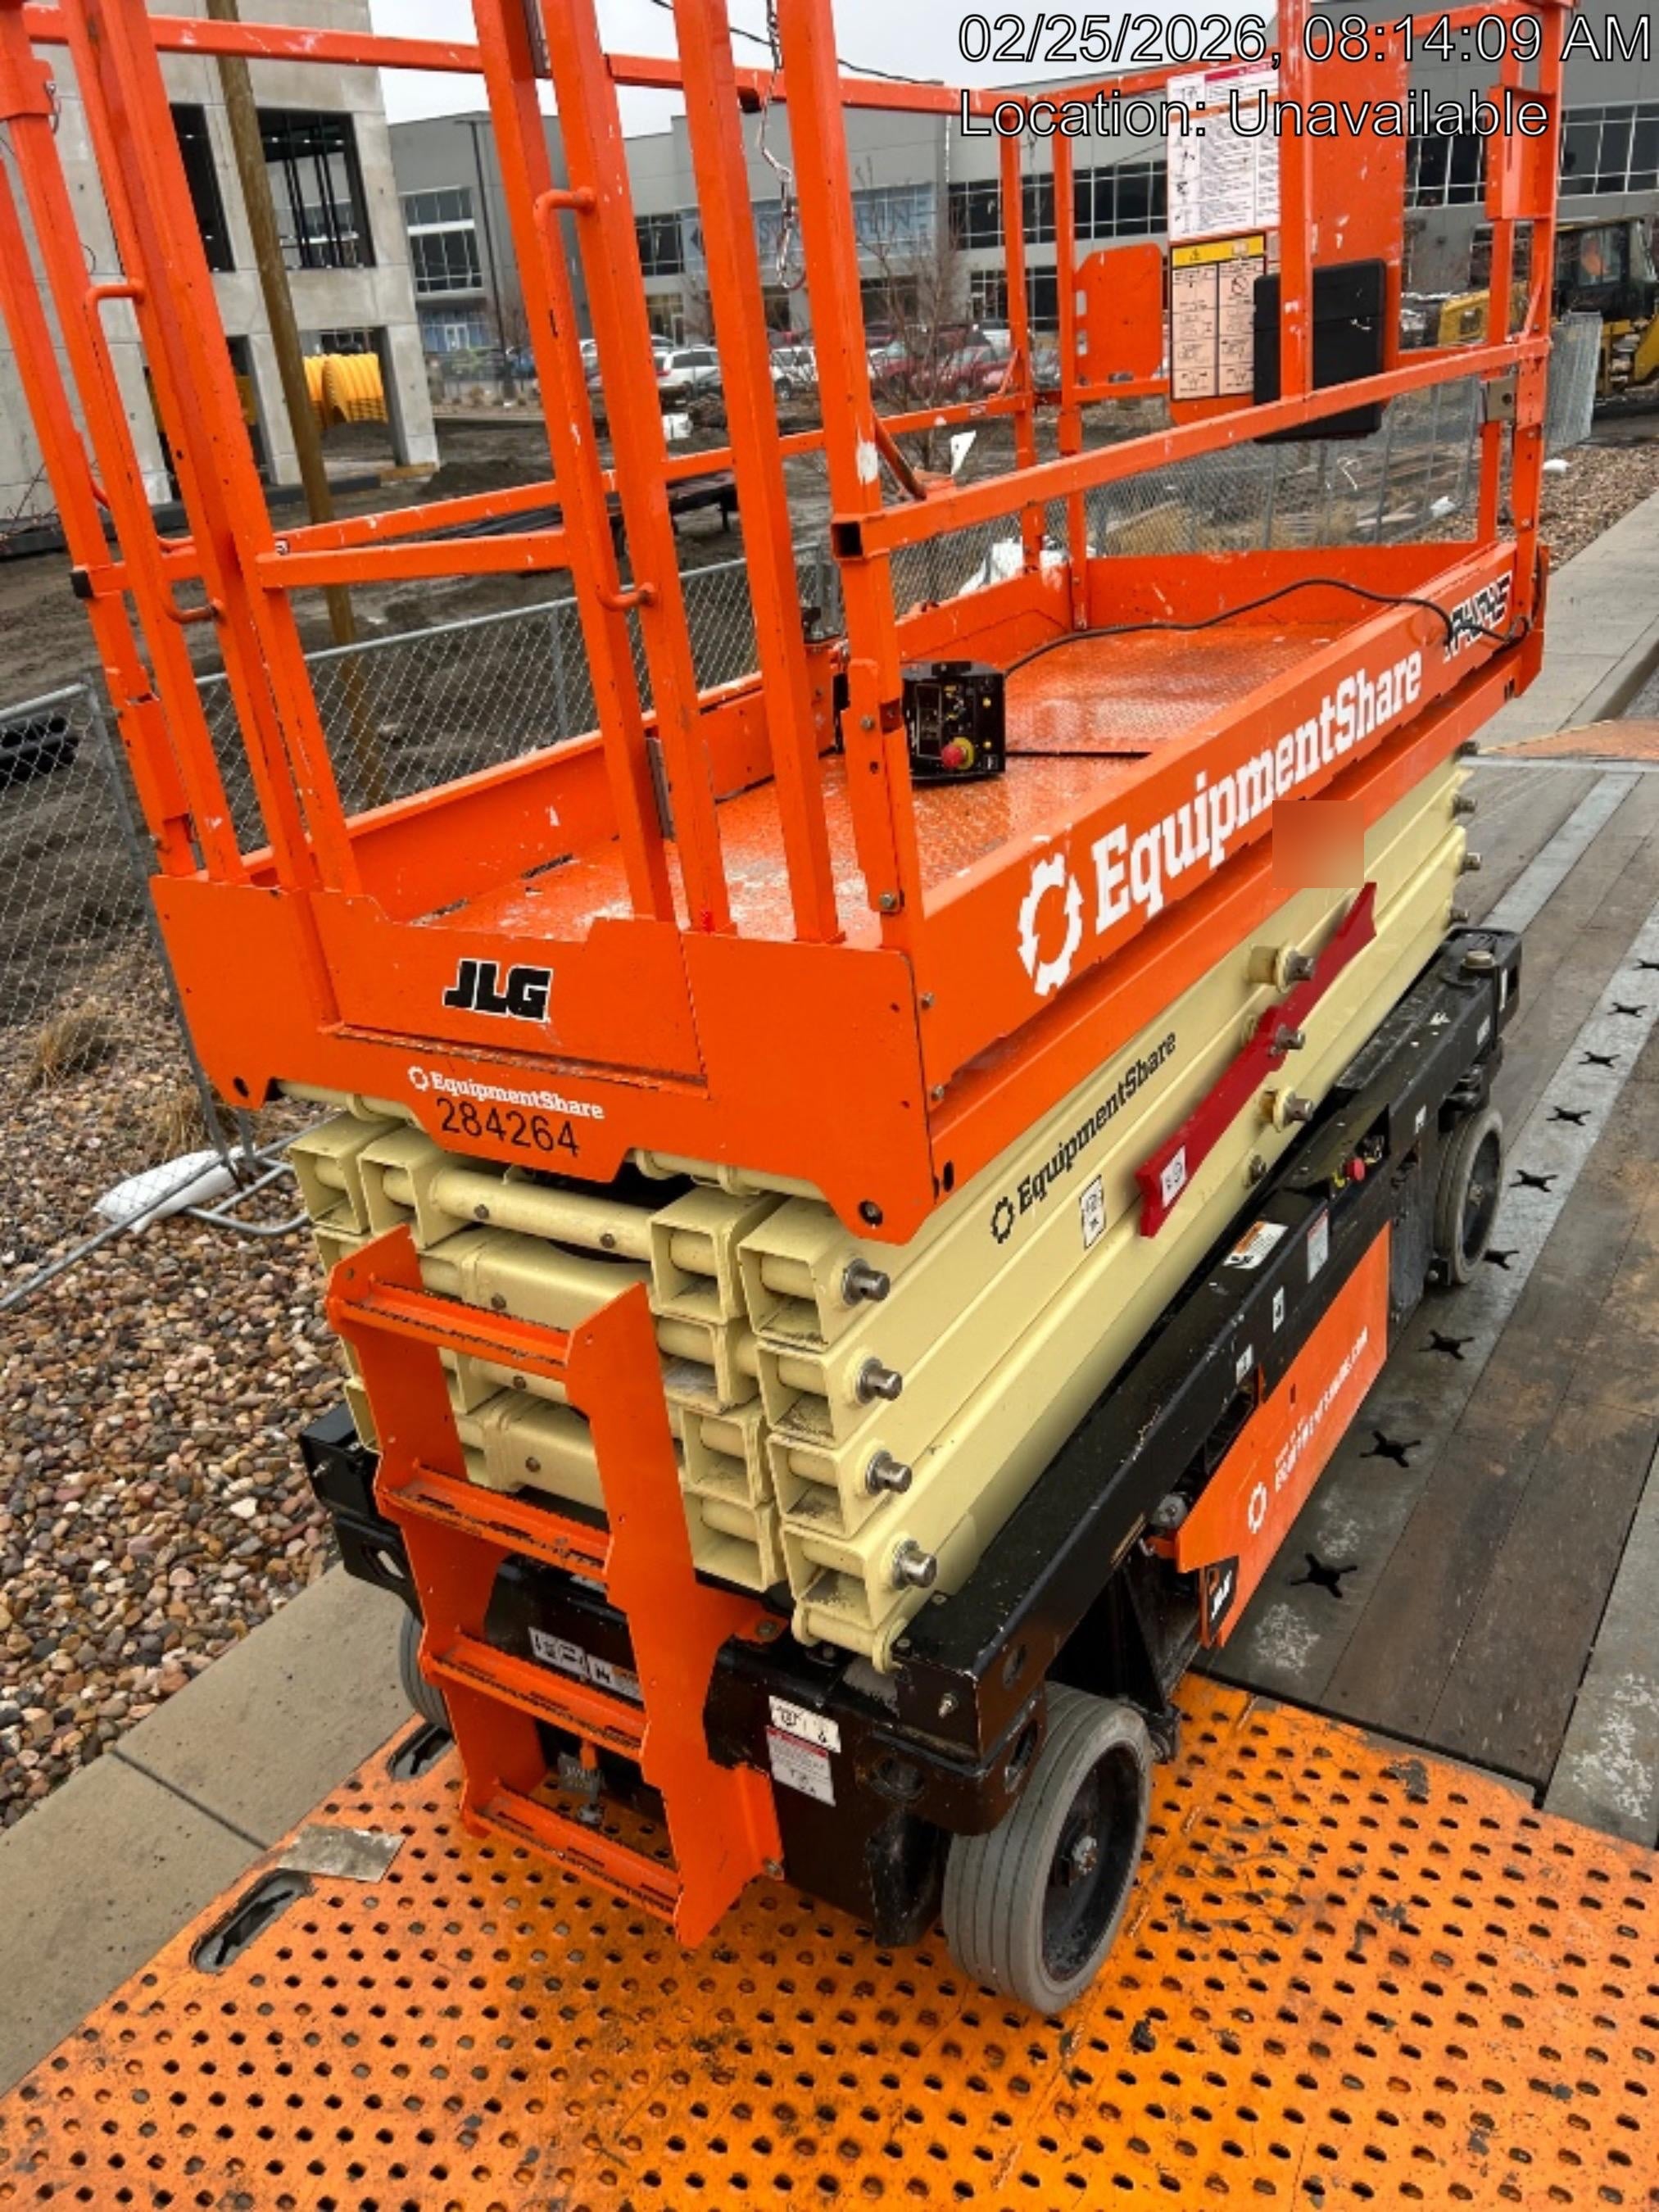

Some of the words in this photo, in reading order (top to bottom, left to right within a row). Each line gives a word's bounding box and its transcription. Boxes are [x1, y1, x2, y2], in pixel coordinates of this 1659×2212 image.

[1092, 650, 1421, 935] EquipmentShare
[444, 959, 552, 1022] JLG
[432, 1072, 603, 1119] EquipmentShare
[437, 1099, 578, 1155] 284264
[1016, 1031, 1177, 1215] EquipmentShare
